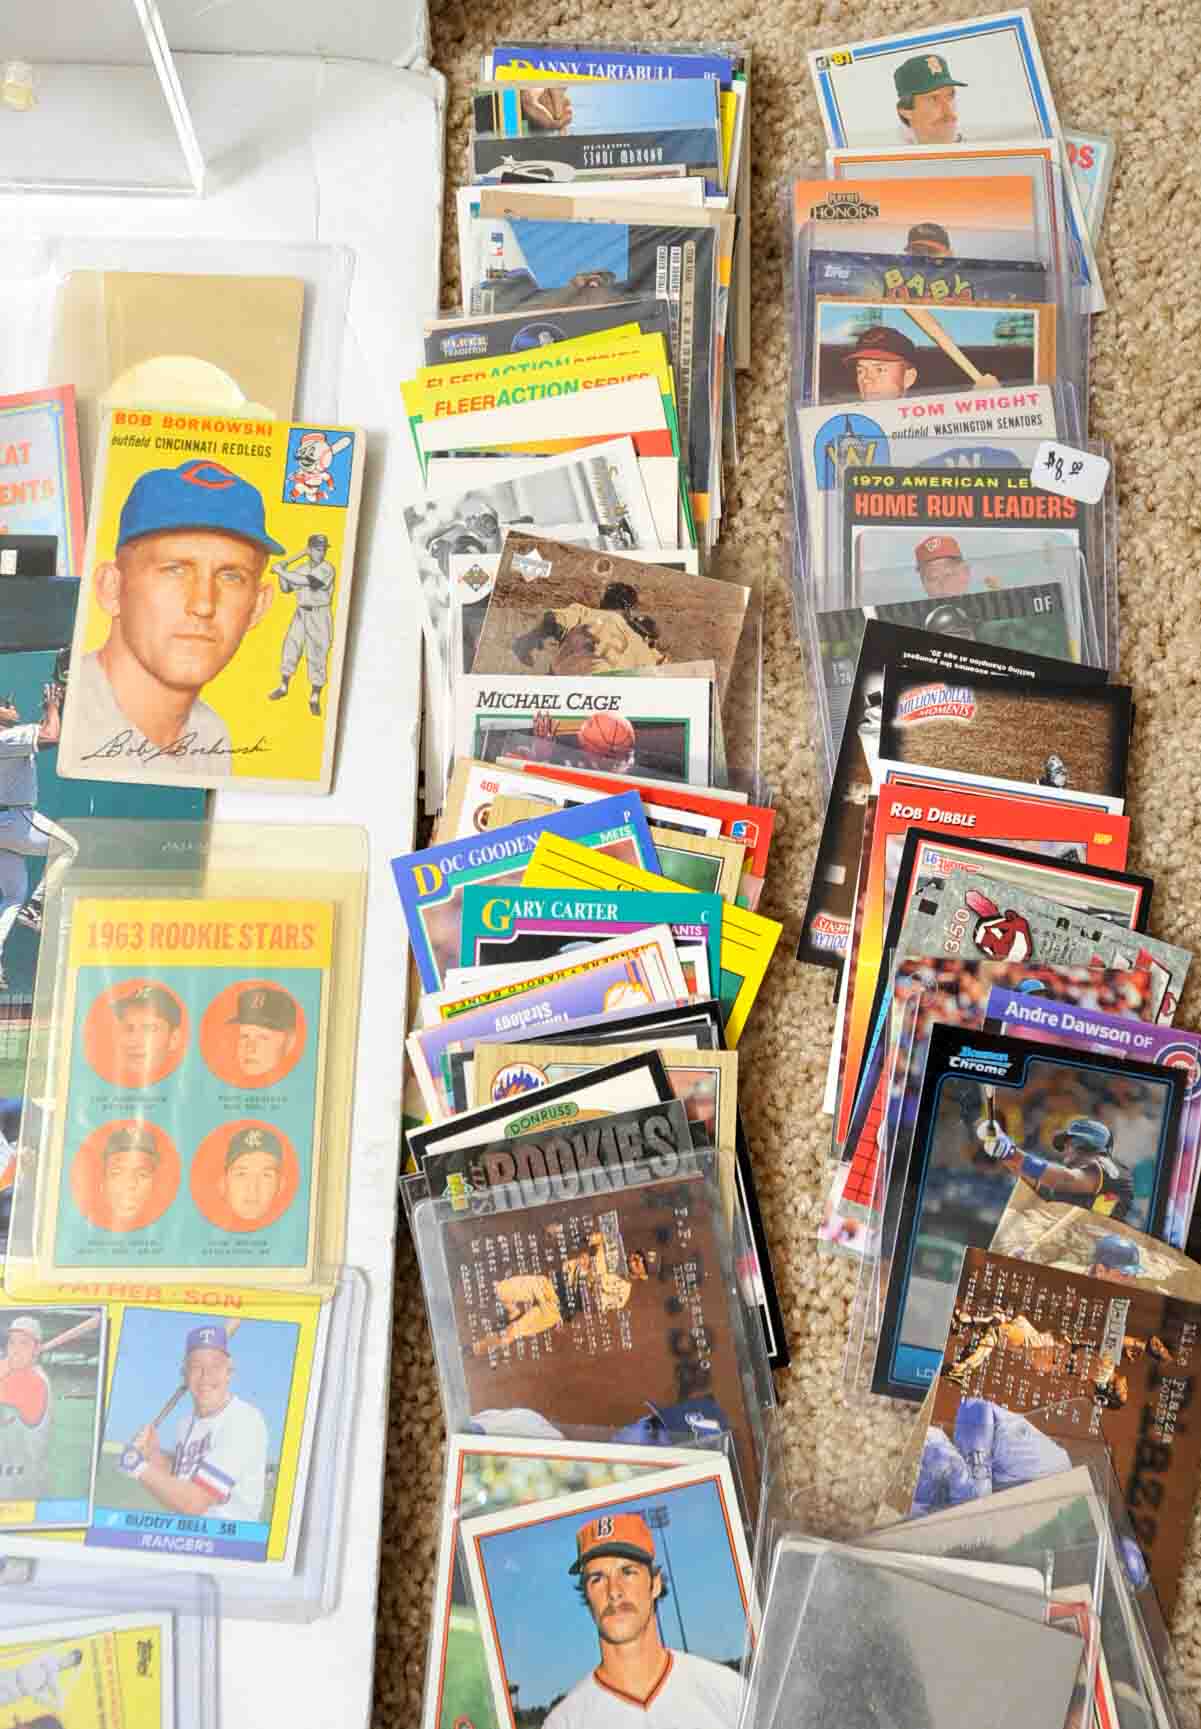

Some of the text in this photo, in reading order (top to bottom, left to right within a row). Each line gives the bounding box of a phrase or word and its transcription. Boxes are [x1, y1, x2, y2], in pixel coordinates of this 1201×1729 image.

[808, 205, 881, 219] HONORS
[883, 266, 973, 300] BABY
[434, 394, 496, 416] FLEER
[496, 378, 580, 407] ACTION
[898, 393, 1040, 418] TOM WRIGHT
[114, 411, 274, 437] BOB BORKOWSKI
[891, 414, 1043, 440] outfield WASHINGTON SENATORS
[111, 434, 272, 458] outfield CINCINNATI REDLEGS
[852, 476, 1034, 489] 1970 AMERICAN LE
[855, 493, 1078, 519] HOME RUN LEADERS
[1033, 595, 1054, 614] OF
[476, 691, 622, 711] MICHAEL CAGE
[898, 688, 939, 715] MILLION
[889, 801, 977, 828] ROB DIBBLE
[600, 825, 633, 844] METS
[412, 832, 541, 898] DOC GOODEN
[481, 898, 619, 931] GARY CARTER
[700, 910, 710, 923] C
[88, 921, 316, 952] 1963 ROOKIE STARS
[672, 925, 703, 937] ANTS
[1004, 1000, 1059, 1027] Andre
[1061, 1014, 1131, 1044] Dawson
[1133, 1035, 1154, 1049] OF
[949, 1056, 1009, 1077] Chrome
[510, 1106, 574, 1135] DONRUSS
[481, 1114, 681, 1210] ROOKIES
[183, 1288, 243, 1309] SON
[1162, 1377, 1185, 1443] Piazza
[126, 1515, 237, 1536] BUDDY BELL 3B
[140, 1535, 215, 1553] RANGERS
